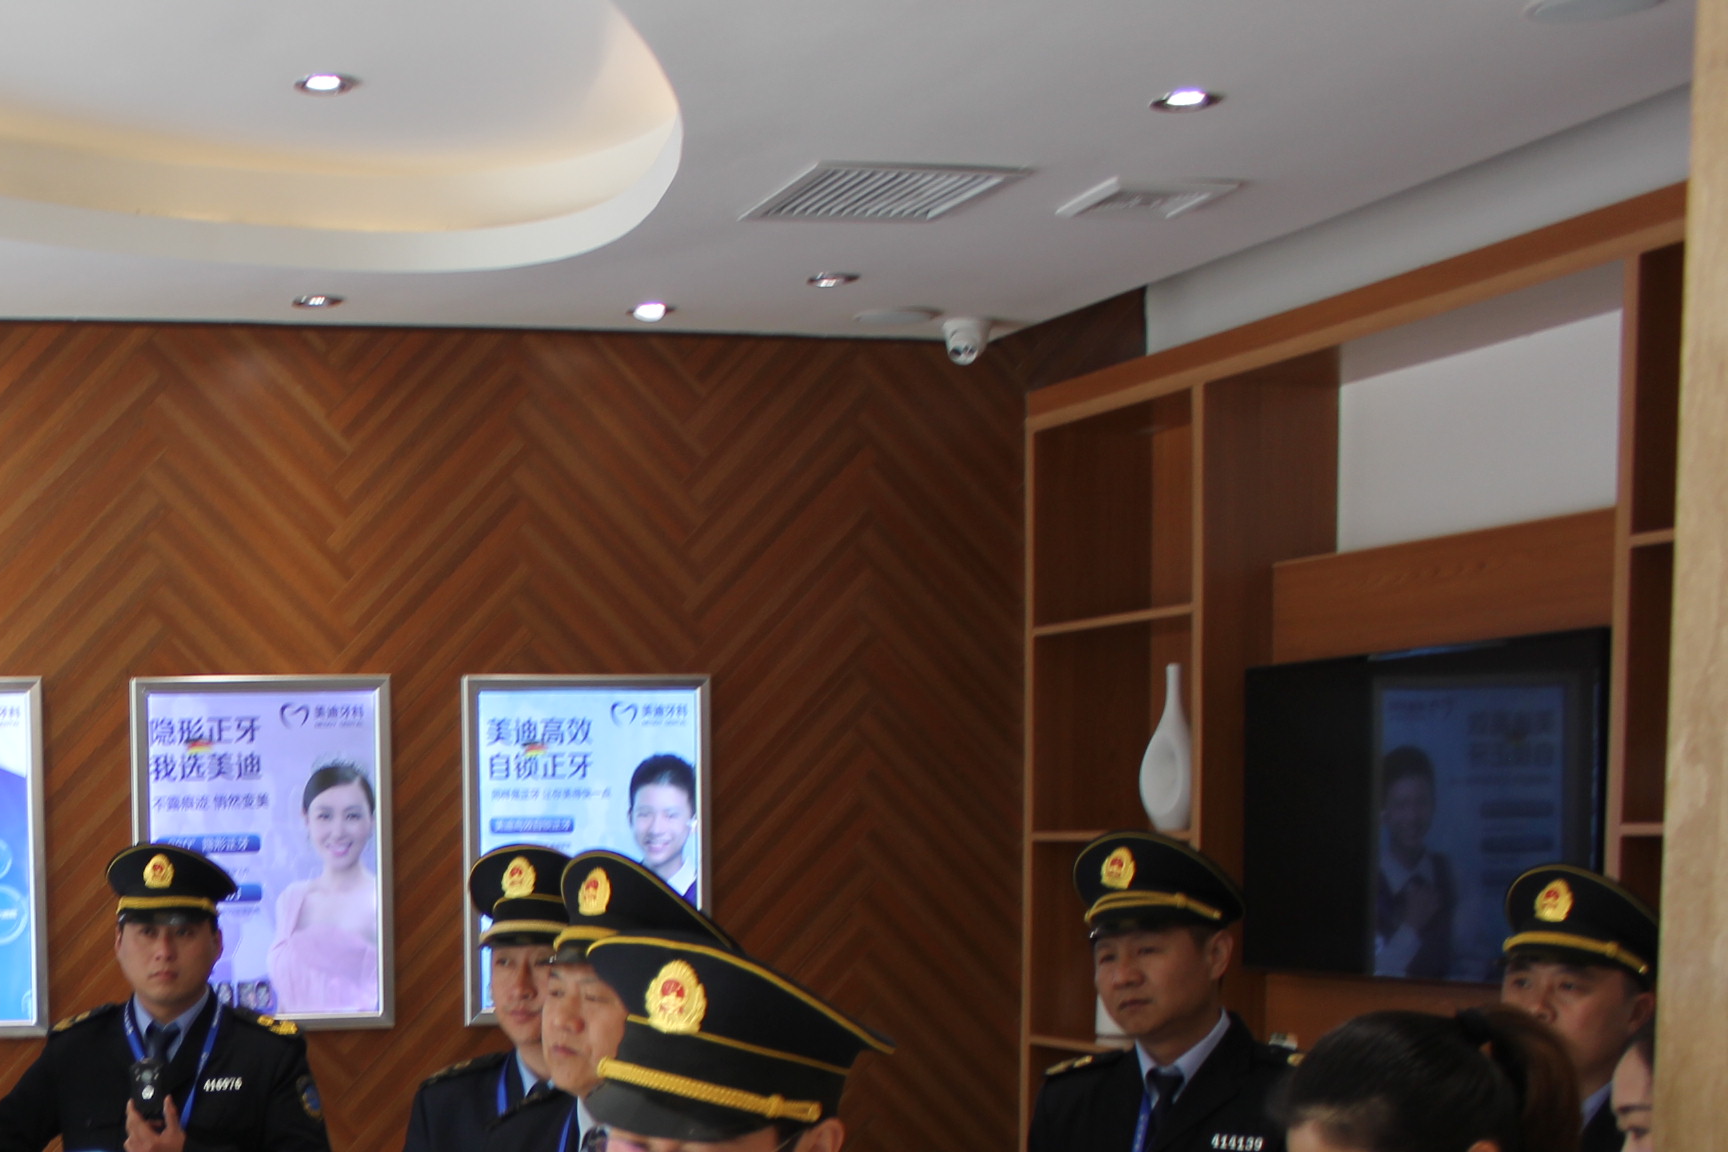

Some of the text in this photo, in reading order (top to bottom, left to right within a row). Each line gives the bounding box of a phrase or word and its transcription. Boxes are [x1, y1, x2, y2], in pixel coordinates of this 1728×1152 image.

[150, 716, 261, 745] 隐形正牙
[487, 716, 593, 746] 美迪高效
[150, 752, 262, 782] 我选美迪
[489, 752, 593, 781] 自锁正牙
[1211, 1133, 1264, 1152] 414139
